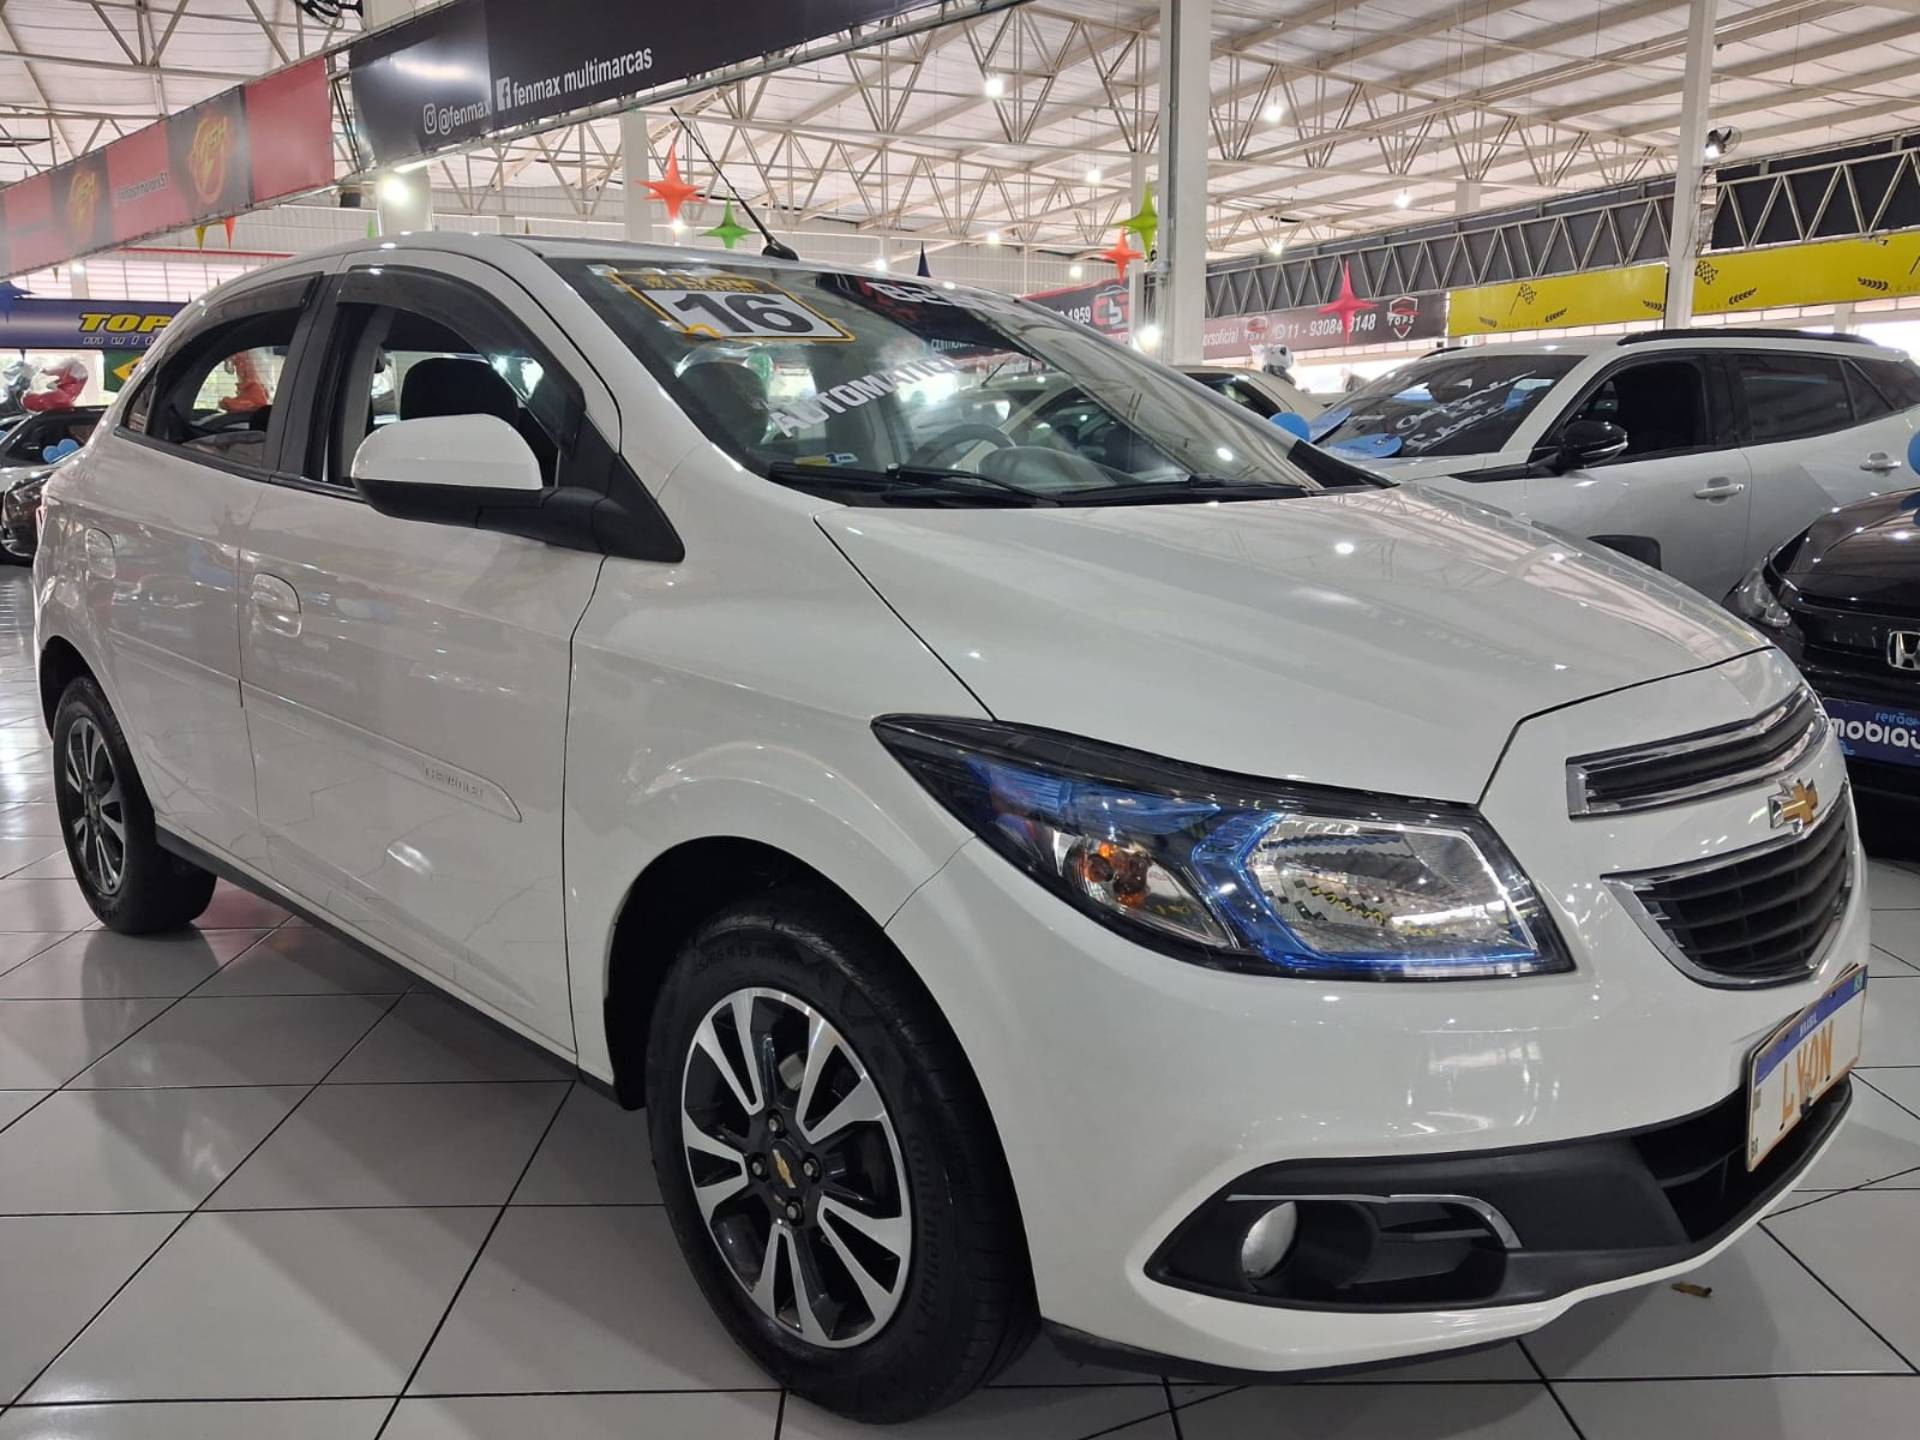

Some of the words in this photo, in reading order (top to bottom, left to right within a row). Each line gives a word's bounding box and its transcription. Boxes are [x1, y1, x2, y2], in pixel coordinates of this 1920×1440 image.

[513, 76, 561, 107] fenmax
[564, 47, 653, 93] multimarcas
[673, 293, 814, 333] 16
[1388, 316, 1415, 326] TOPS
[1287, 324, 1299, 339] 11
